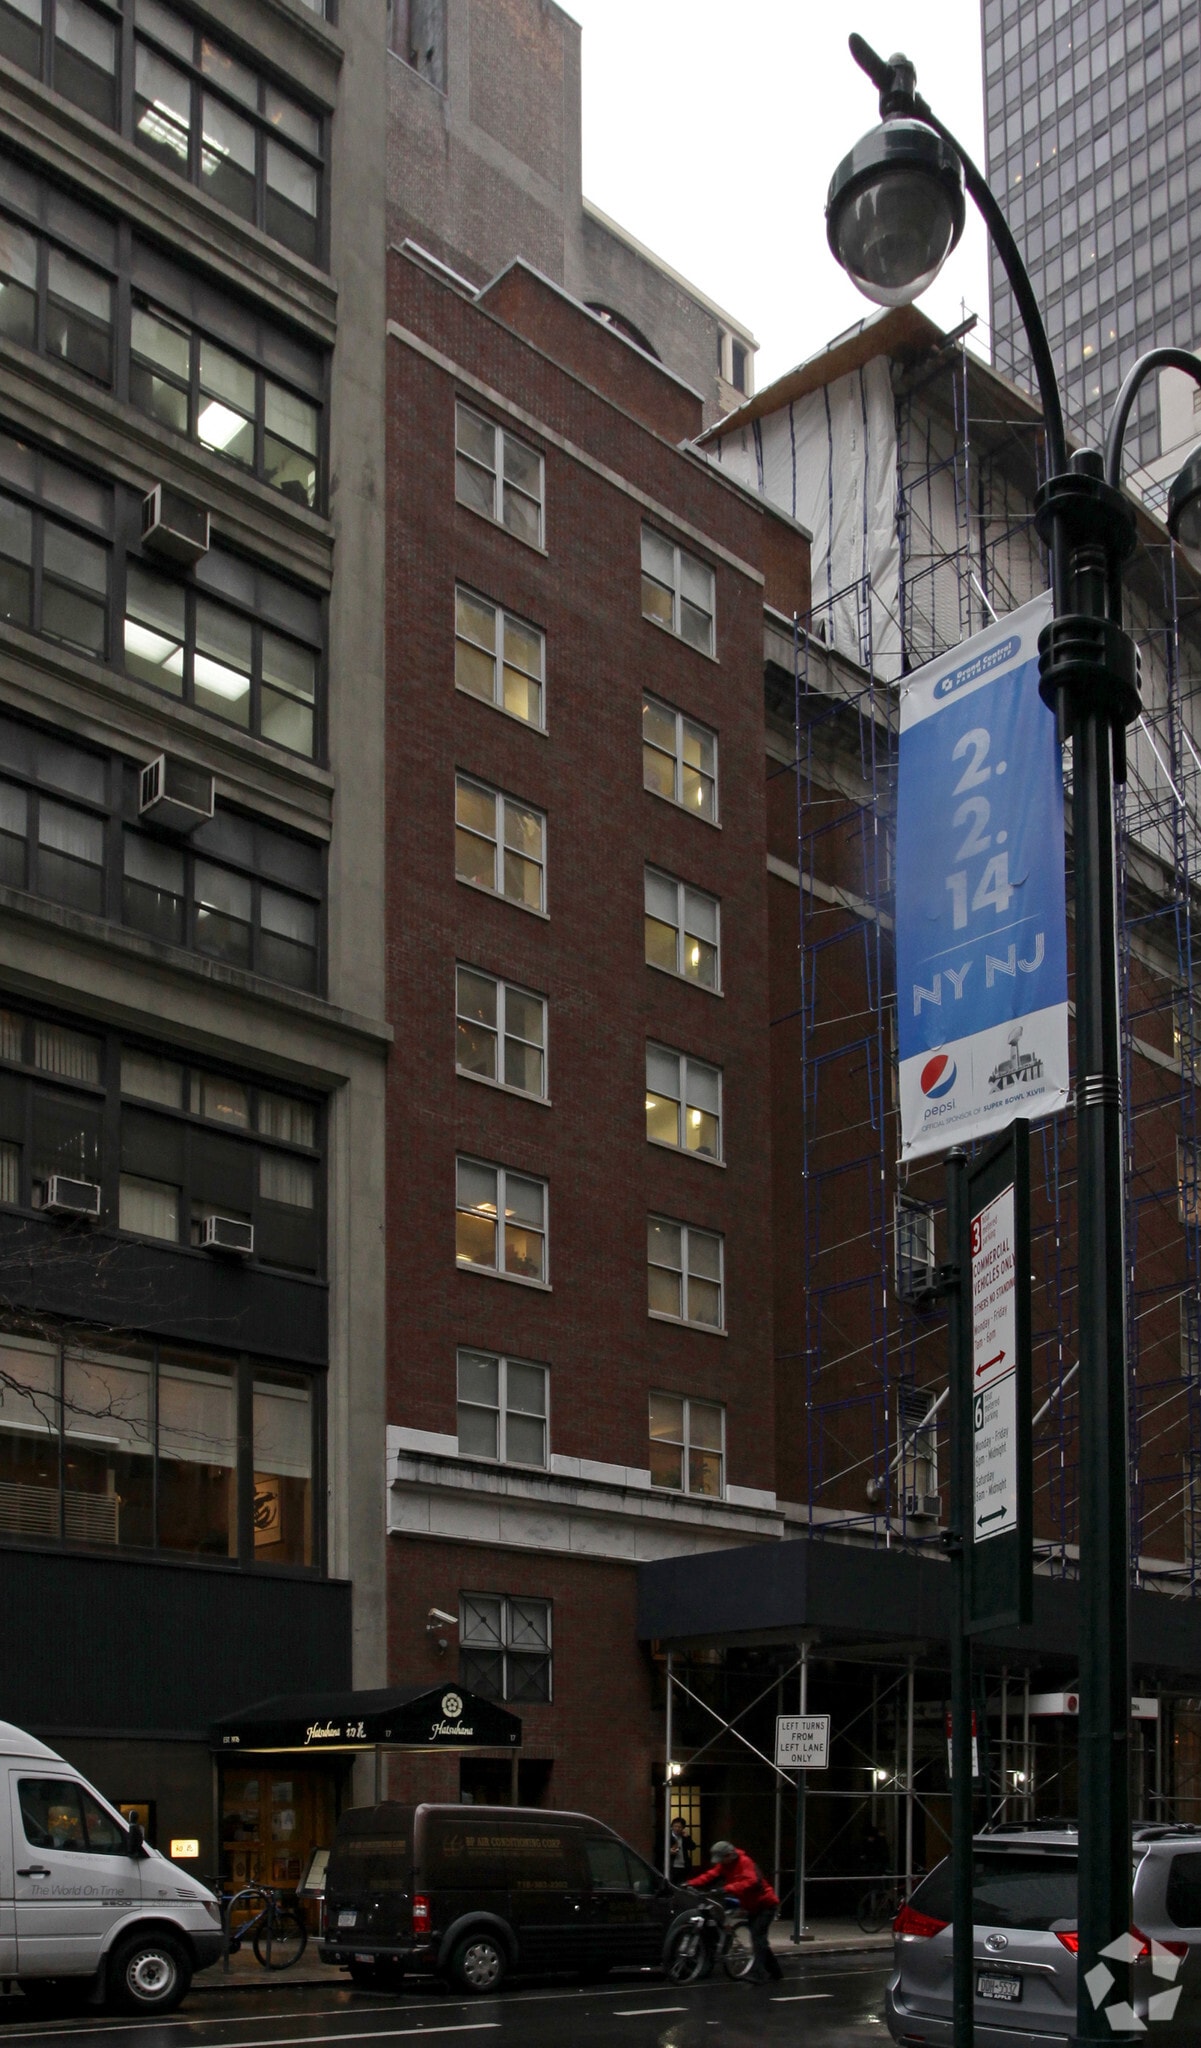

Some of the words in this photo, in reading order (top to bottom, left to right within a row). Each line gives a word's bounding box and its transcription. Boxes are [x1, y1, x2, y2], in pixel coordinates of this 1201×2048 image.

[957, 660, 981, 679] Grand
[983, 641, 1012, 664] Central
[951, 728, 1007, 797] 2.
[952, 796, 1008, 863] 2.
[945, 850, 1014, 931] 14
[913, 960, 974, 1017] NY
[986, 931, 1045, 989] NJ
[921, 1113, 945, 1132] OFFICIAL
[946, 1105, 972, 1125] SPONSOR
[973, 1105, 982, 1115] OF
[983, 1097, 1003, 1112] SUPER
[1004, 1092, 1024, 1105] BOWL
[923, 1098, 955, 1120] pepsi
[973, 1221, 981, 1254] 3
[973, 1237, 1010, 1278] COMMERCIAL
[973, 1264, 999, 1296] VEHICLES
[973, 1296, 989, 1316] OTHERS
[989, 1291, 996, 1305] NO
[993, 1305, 1008, 1322] Friday
[975, 1396, 983, 1429] 6
[994, 1427, 1009, 1442] Friday
[428, 1719, 474, 1741] Hatsuhana
[782, 1722, 799, 1731] LEFT
[802, 1721, 825, 1731] TURNS
[791, 1732, 814, 1741] FROM
[780, 1743, 799, 1752] LEFT
[803, 1743, 824, 1752] LANE
[791, 1754, 812, 1763] ONLY
[490, 1837, 541, 1848] CONDITIONING
[31, 1884, 49, 1897] The
[51, 1884, 82, 1897] World
[83, 1884, 98, 1897] On
[100, 1885, 125, 1897] Time
